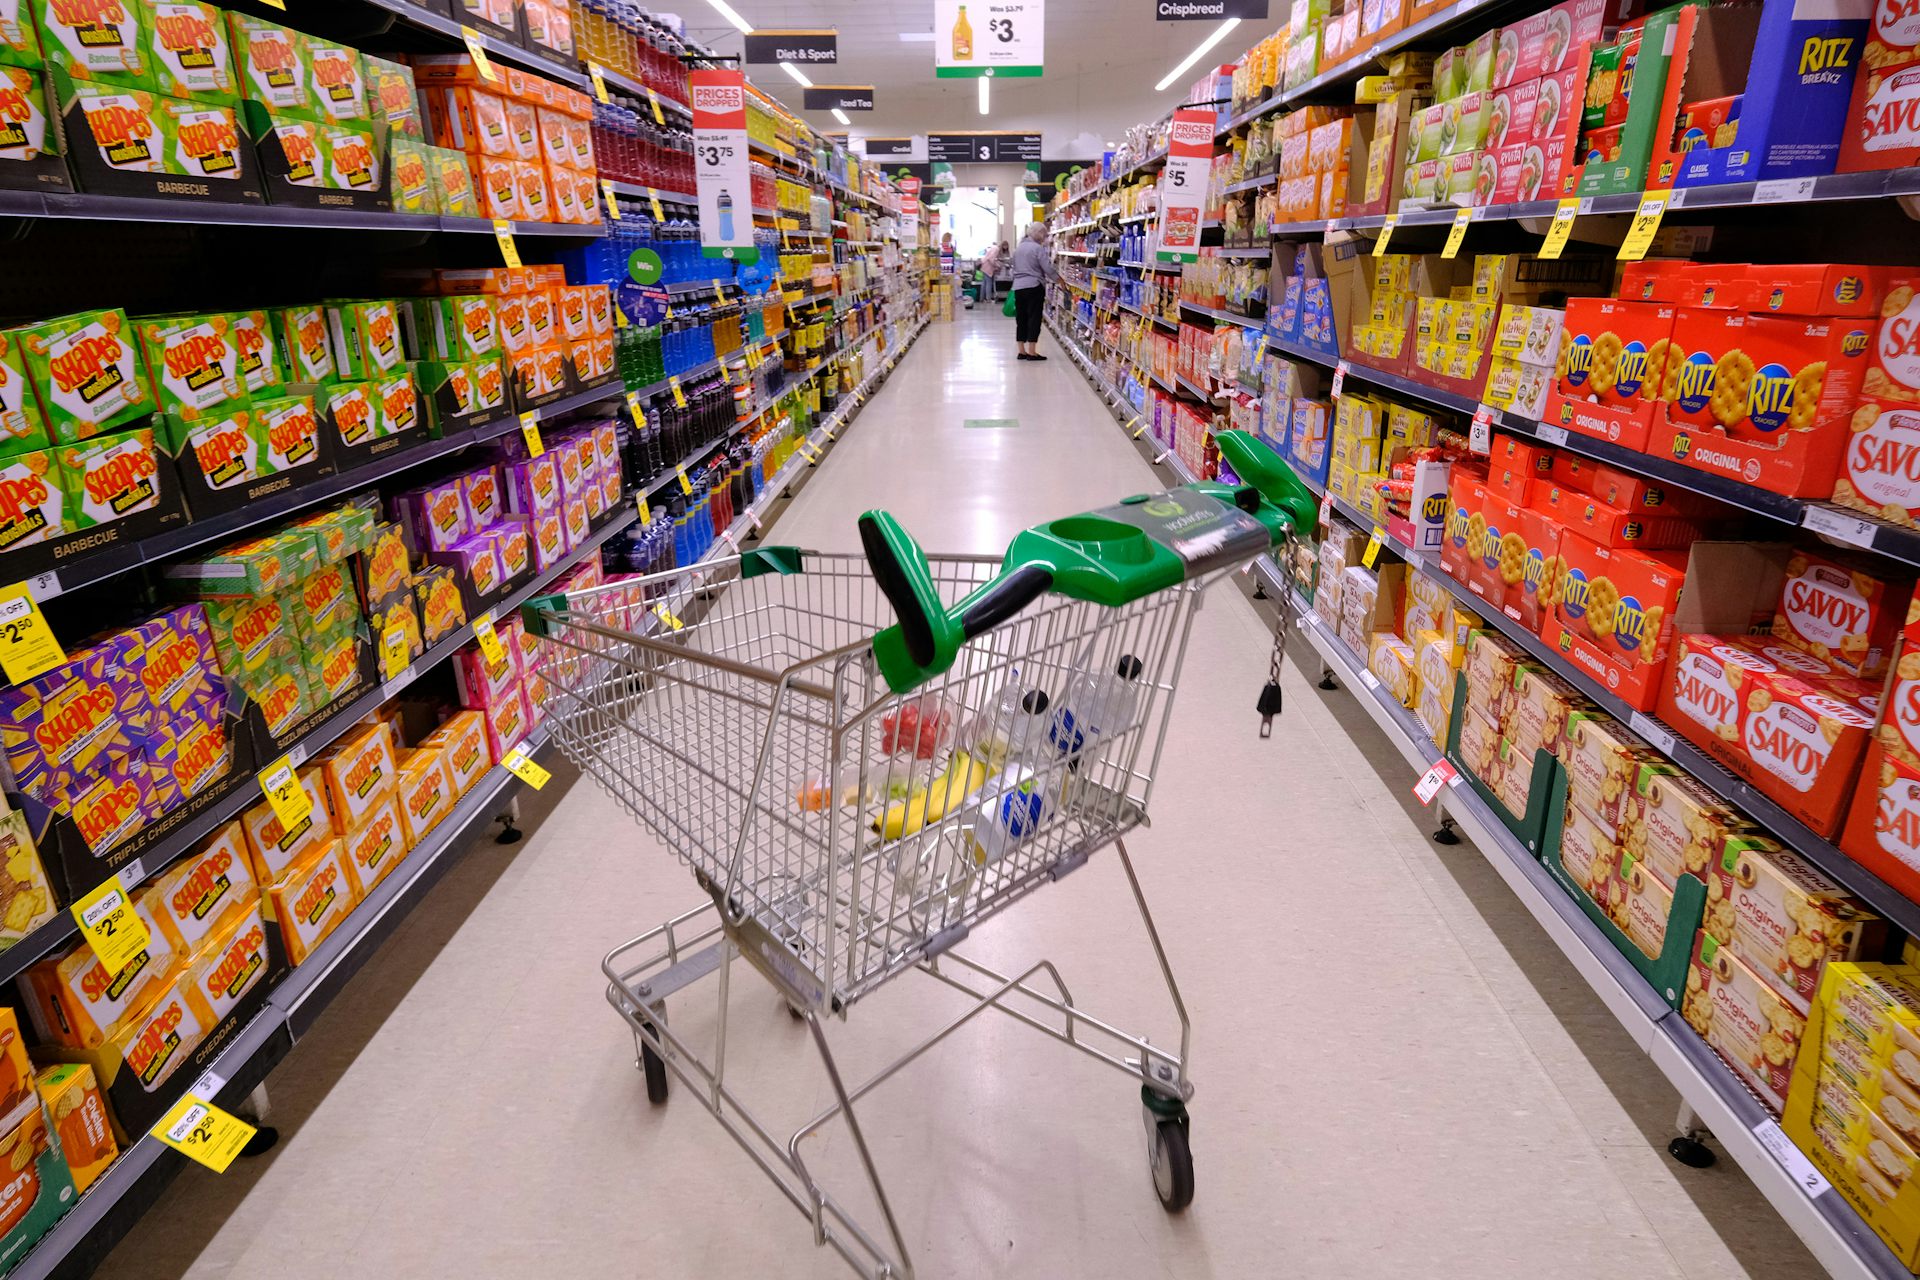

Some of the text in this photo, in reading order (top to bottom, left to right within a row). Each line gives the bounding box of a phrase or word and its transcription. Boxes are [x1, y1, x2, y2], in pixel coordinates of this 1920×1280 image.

[1159, 2, 1224, 18] Crispbread
[82, 30, 121, 44] ORIGINALS
[989, 18, 1014, 42] $3
[181, 53, 213, 67] ORIGINALS
[776, 49, 836, 62] Diet & Sport
[1798, 37, 1854, 75] RITZ
[1801, 71, 1842, 85] BREAKZ
[695, 88, 739, 99] PRICES
[696, 99, 741, 108] DROPPED
[840, 99, 872, 108] Iced Tea
[1514, 85, 1536, 103] RYVITA
[1174, 132, 1212, 142] DROPPED
[1175, 123, 1212, 135] PRICES
[110, 144, 149, 162] ORIGINALS
[202, 155, 235, 173] ORIGINALS
[979, 146, 991, 160] 3
[1500, 149, 1521, 166] RYVITA
[157, 181, 210, 197] BARBECUE
[1168, 170, 1185, 187] $5
[319, 194, 354, 206] BARBECUE
[637, 261, 653, 272] Win
[1837, 276, 1857, 304] RITZ
[1840, 332, 1870, 354] RITZ
[1565, 343, 1594, 375] RITZ
[1613, 349, 1649, 385] RITZ
[83, 370, 121, 400] ORIGINALS
[188, 367, 222, 389] ORIGINALS
[1676, 360, 1716, 399] RITZ
[1746, 373, 1797, 417] RITZ
[1560, 404, 1573, 422] RITZ
[1754, 416, 1779, 427] CRACKERS
[1576, 415, 1608, 434] ORIGINAL
[371, 438, 400, 454] BARBECUE
[1673, 434, 1692, 455] RITZ
[1695, 448, 1742, 473] ORIGINAL
[213, 459, 245, 485] ORIGINALS
[248, 477, 291, 499] BARBECUE
[1873, 481, 1910, 499] original
[114, 487, 152, 513] ORIGINALS
[1451, 513, 1470, 539] RITZ
[1624, 521, 1639, 541] RITZ
[53, 528, 118, 559] BARBECUE
[1482, 532, 1503, 562] RITZ
[1522, 555, 1545, 586] RITZ
[1562, 577, 1592, 608] RITZ
[6, 602, 24, 615] OFF
[1788, 581, 1866, 635] SAVOY
[1612, 600, 1648, 641] RITZ
[1804, 621, 1833, 640] original
[1347, 633, 1362, 652] SAO
[1558, 632, 1572, 648] RITZ
[1574, 648, 1607, 676] ORIGINAL
[1675, 667, 1735, 725] SAVOY
[276, 720, 310, 750] SIZZLING
[310, 705, 333, 729] STEAK
[339, 690, 360, 709] ONION
[1521, 702, 1543, 727] Original
[1463, 730, 1483, 752] Original
[1575, 752, 1601, 784] Original
[1768, 762, 1799, 786] original
[106, 780, 229, 868] TRIPLE CHEESE TOASTIE
[1650, 812, 1685, 848] Original
[1565, 831, 1592, 862] Original
[1779, 854, 1836, 893] Original
[102, 895, 117, 910] OFF
[1631, 898, 1665, 937] Original
[1739, 893, 1787, 940] Original
[1716, 986, 1761, 1036] Original
[195, 1016, 238, 1065] CHEDDAR
[86, 1096, 105, 1143] Chicken
[187, 1108, 201, 1124] OFF
[1811, 1147, 1872, 1218] MULTIGRAIN
